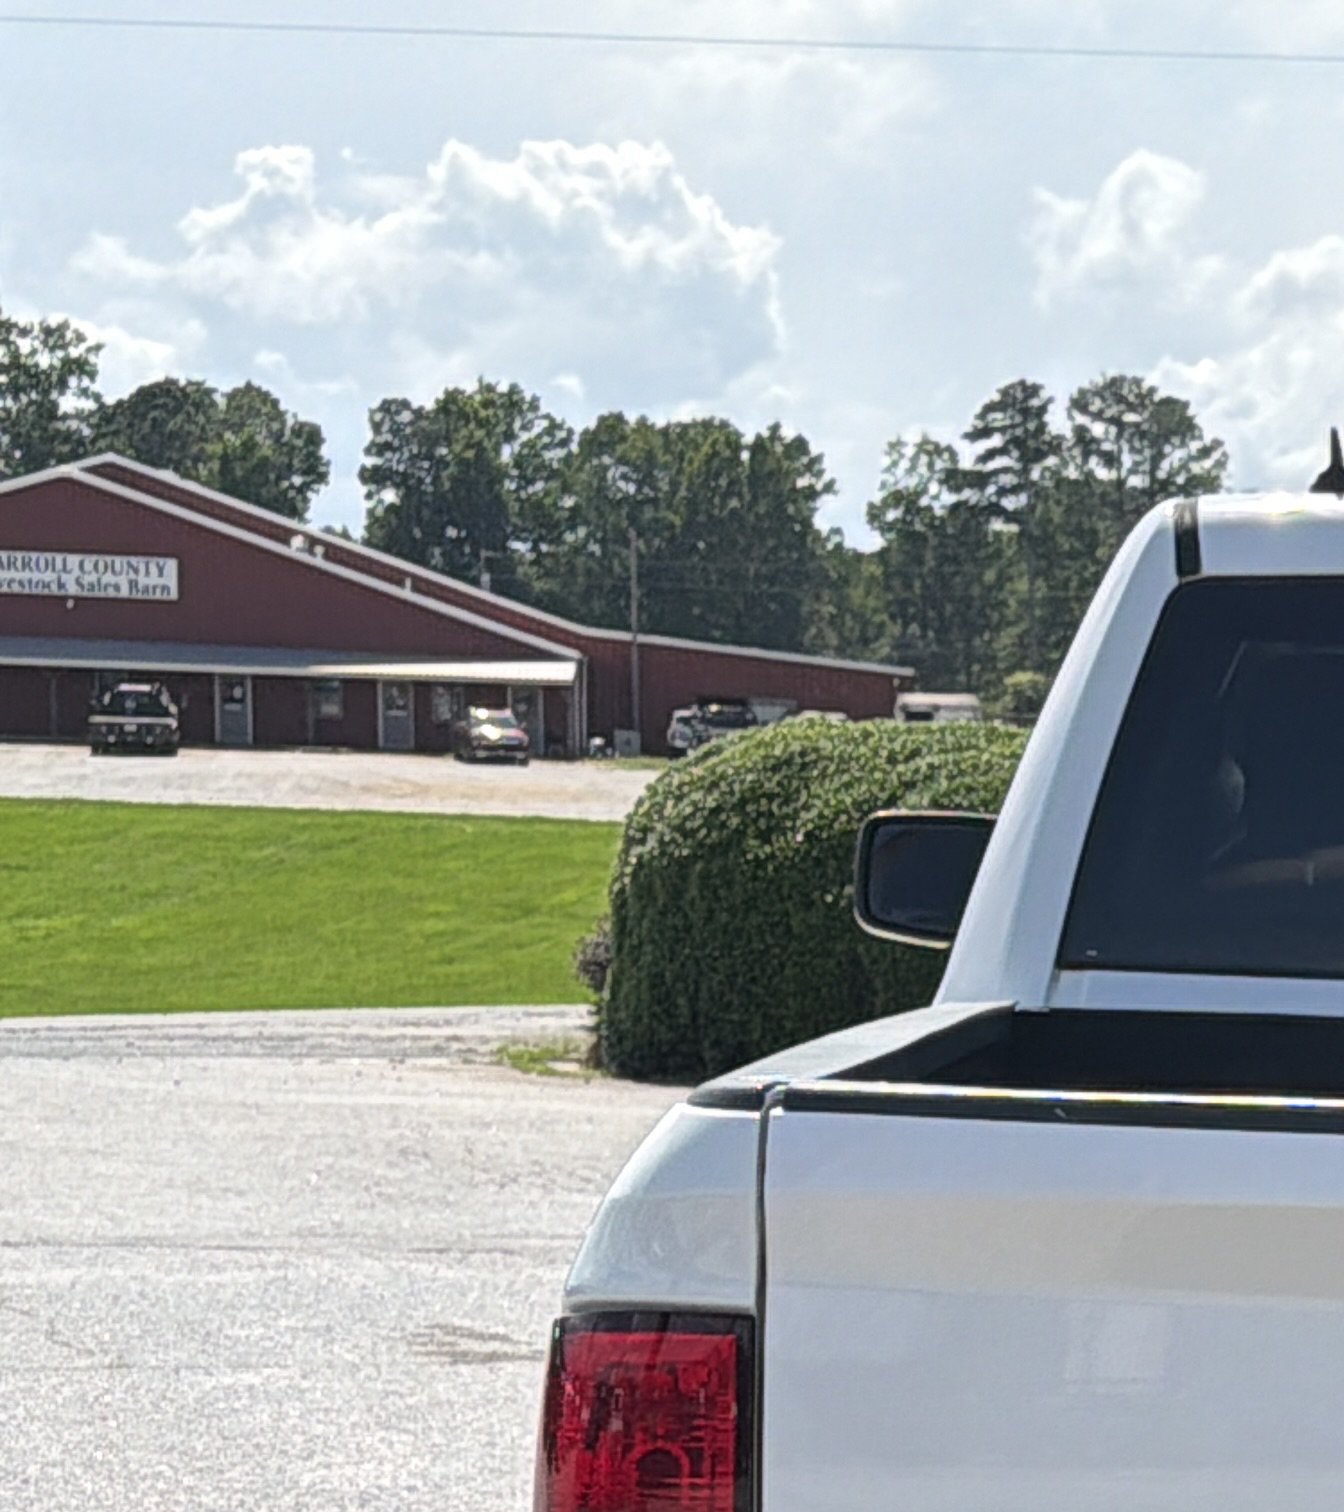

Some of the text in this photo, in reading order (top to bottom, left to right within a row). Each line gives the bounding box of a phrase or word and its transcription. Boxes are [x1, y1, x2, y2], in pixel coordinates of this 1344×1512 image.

[78, 557, 167, 578] COUNTY
[75, 575, 121, 593] Sales
[128, 579, 172, 596] Barn
